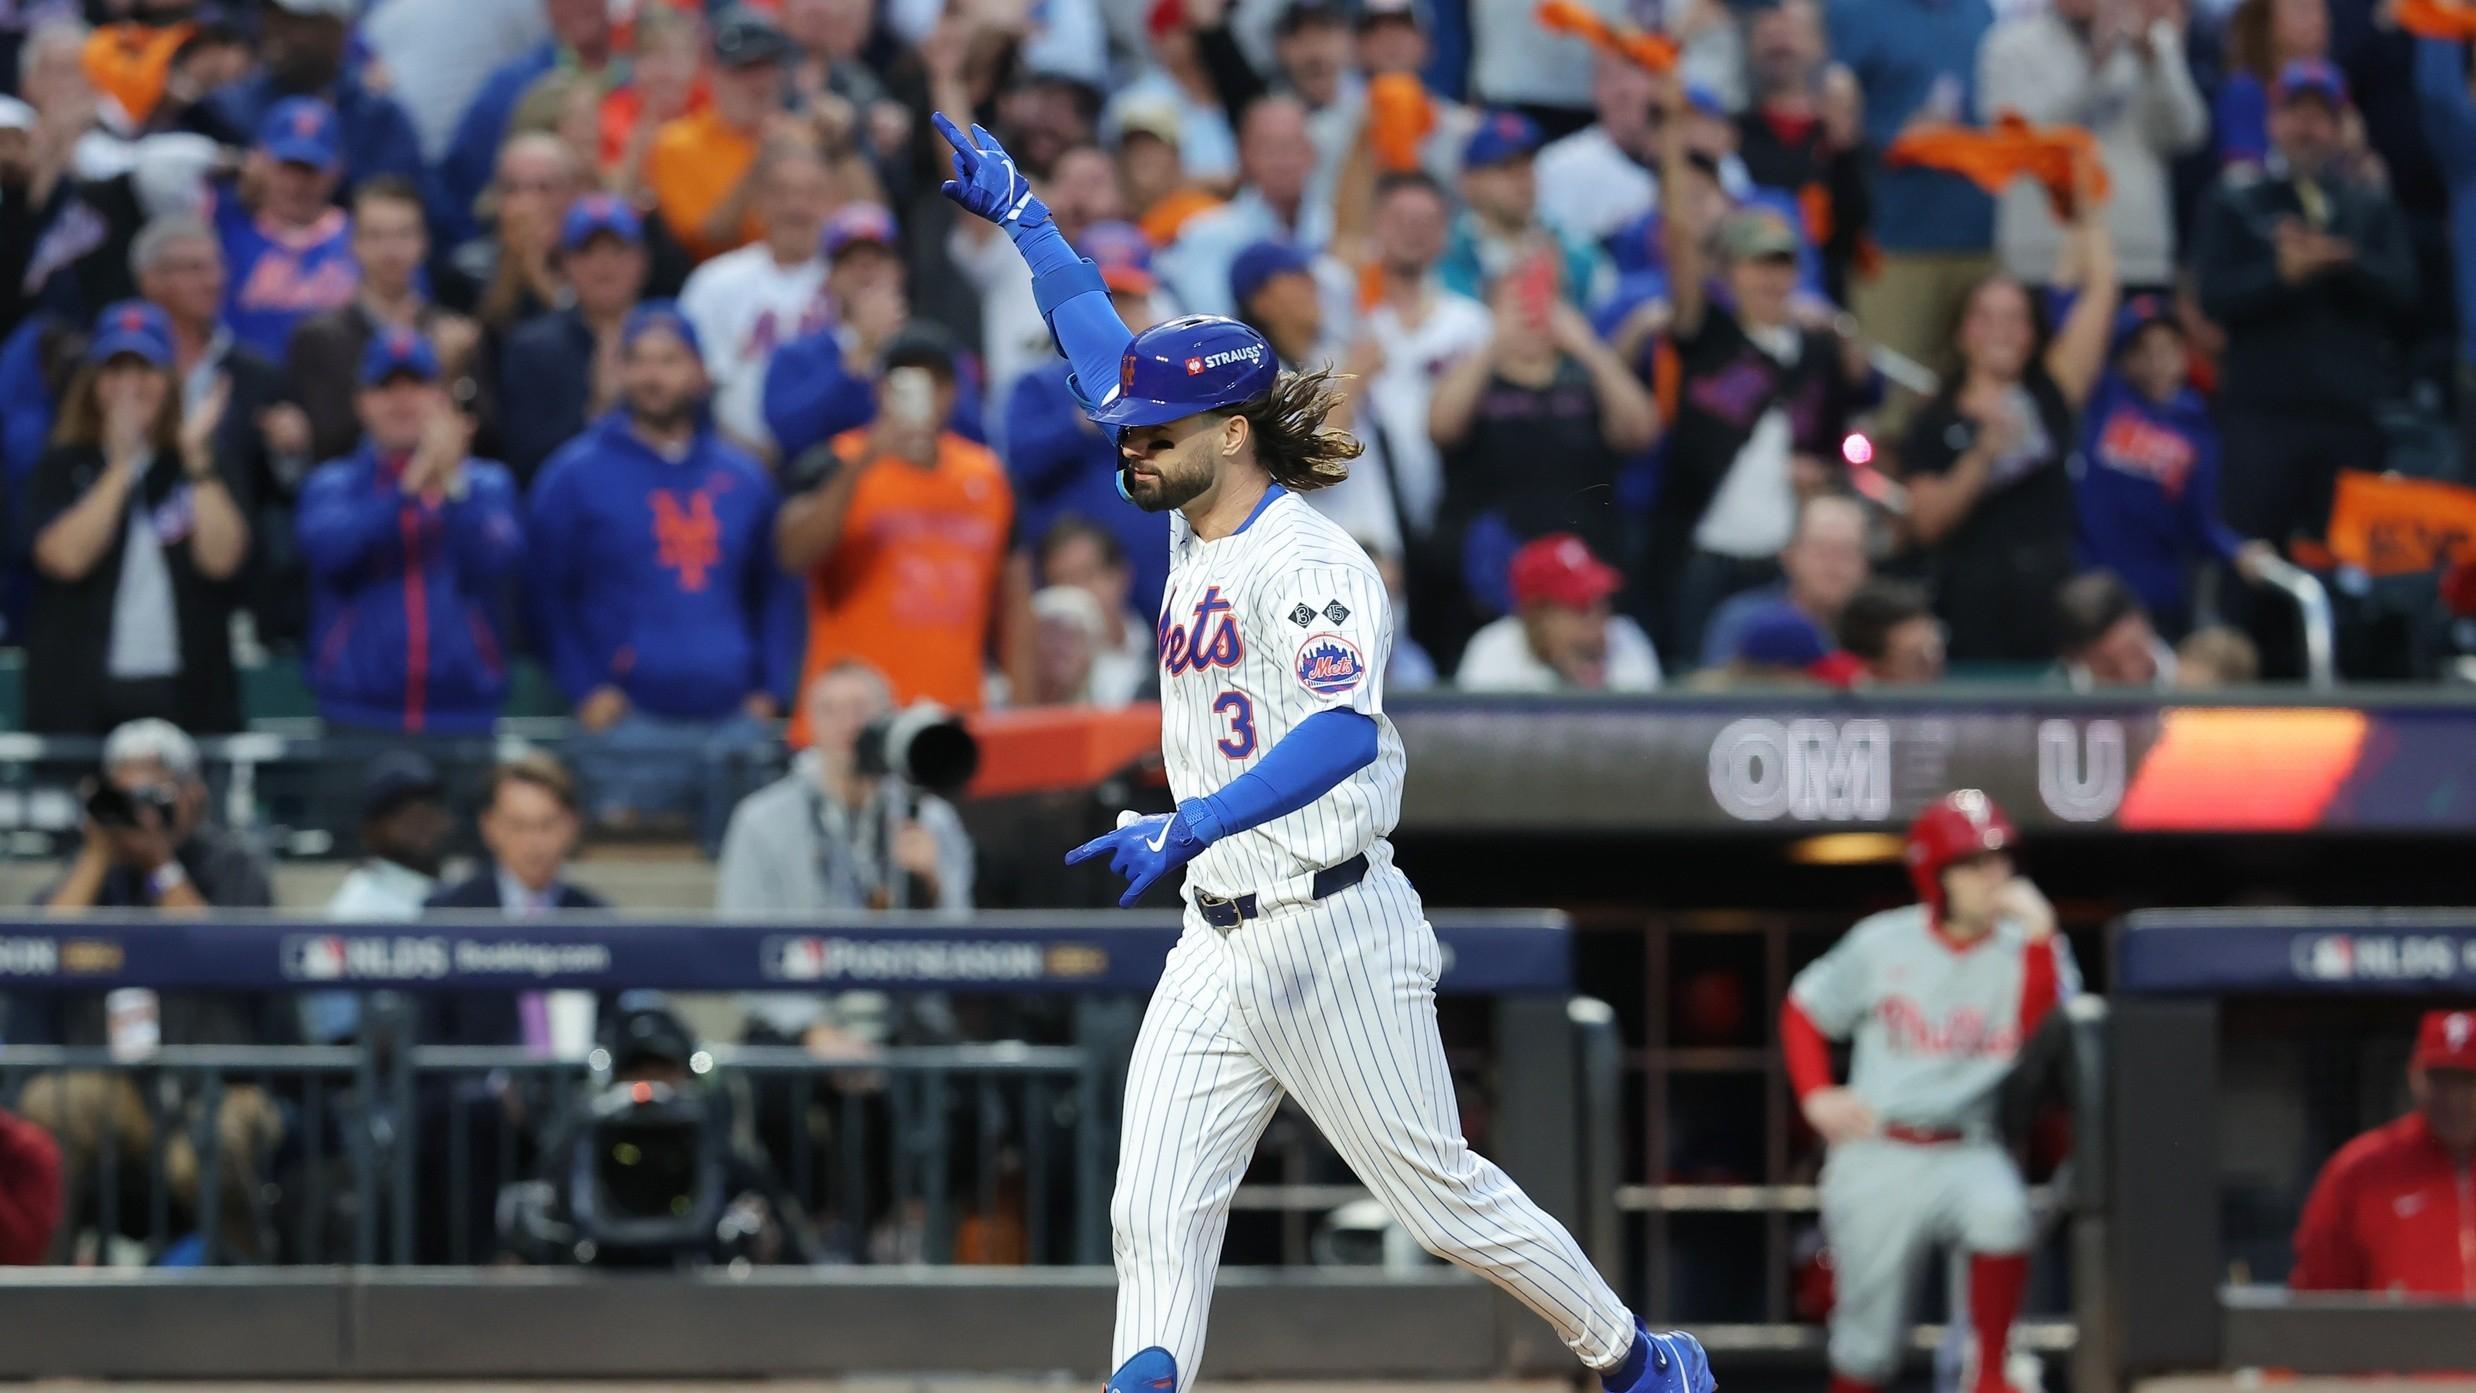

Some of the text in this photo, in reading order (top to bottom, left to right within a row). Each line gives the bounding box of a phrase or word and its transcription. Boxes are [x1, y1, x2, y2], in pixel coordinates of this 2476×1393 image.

[1204, 346, 1260, 368] STRAUSS
[1295, 605, 1311, 626] 3
[1308, 656, 1353, 679] Mets
[1212, 691, 1258, 760] 3
[348, 936, 449, 979] NLDS
[825, 936, 1044, 981] POSTSEASON
